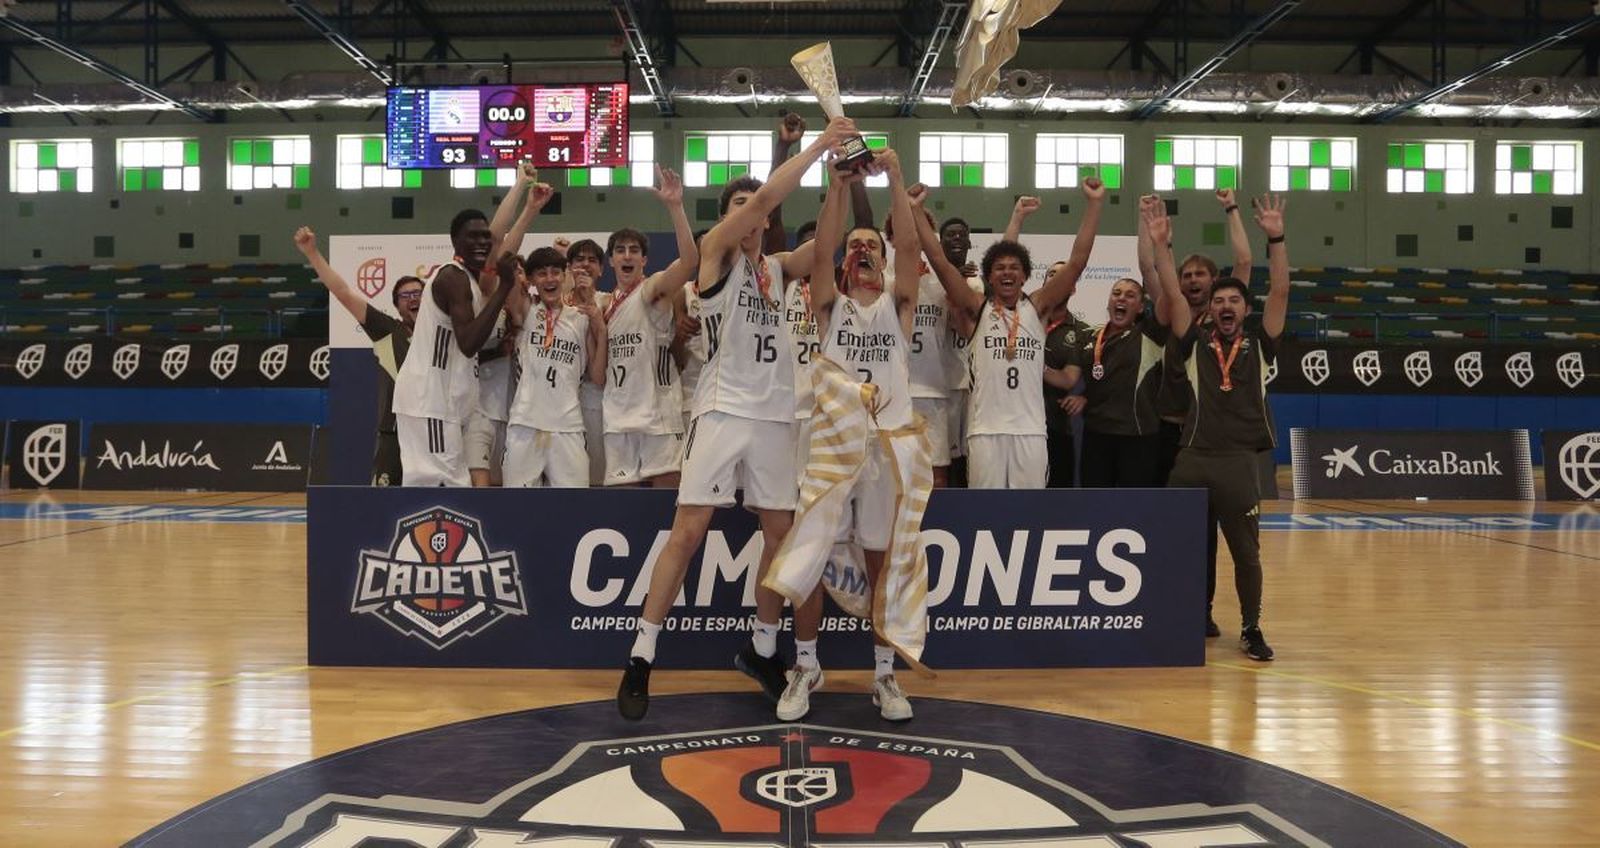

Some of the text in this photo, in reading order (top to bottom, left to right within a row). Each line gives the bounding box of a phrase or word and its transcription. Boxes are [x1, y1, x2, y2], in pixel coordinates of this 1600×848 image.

[488, 107, 525, 121] 00.0
[442, 148, 466, 163] 93
[548, 147, 570, 162] 81
[754, 333, 777, 363] 15
[837, 330, 896, 348] Emirates
[860, 348, 890, 362] BETTER
[1014, 350, 1037, 361] ETTER
[546, 366, 556, 388] 4
[1007, 367, 1019, 389] 8
[97, 439, 221, 471] Andalucía
[1368, 449, 1503, 477] CaixaBank
[570, 528, 1146, 607] CAMONES
[359, 557, 519, 603] CADETE
[571, 616, 677, 631] CAMPEOO
[680, 617, 702, 631] DE
[705, 615, 757, 631] ESPAÑ
[817, 617, 857, 631] UBES
[934, 616, 989, 631] CAMPO
[992, 616, 1014, 631] DE
[1017, 616, 1099, 631] GIBRALTAR
[1103, 615, 1143, 630] 2026
[606, 735, 976, 760] CAMPEONATO DE ESPAÑA
